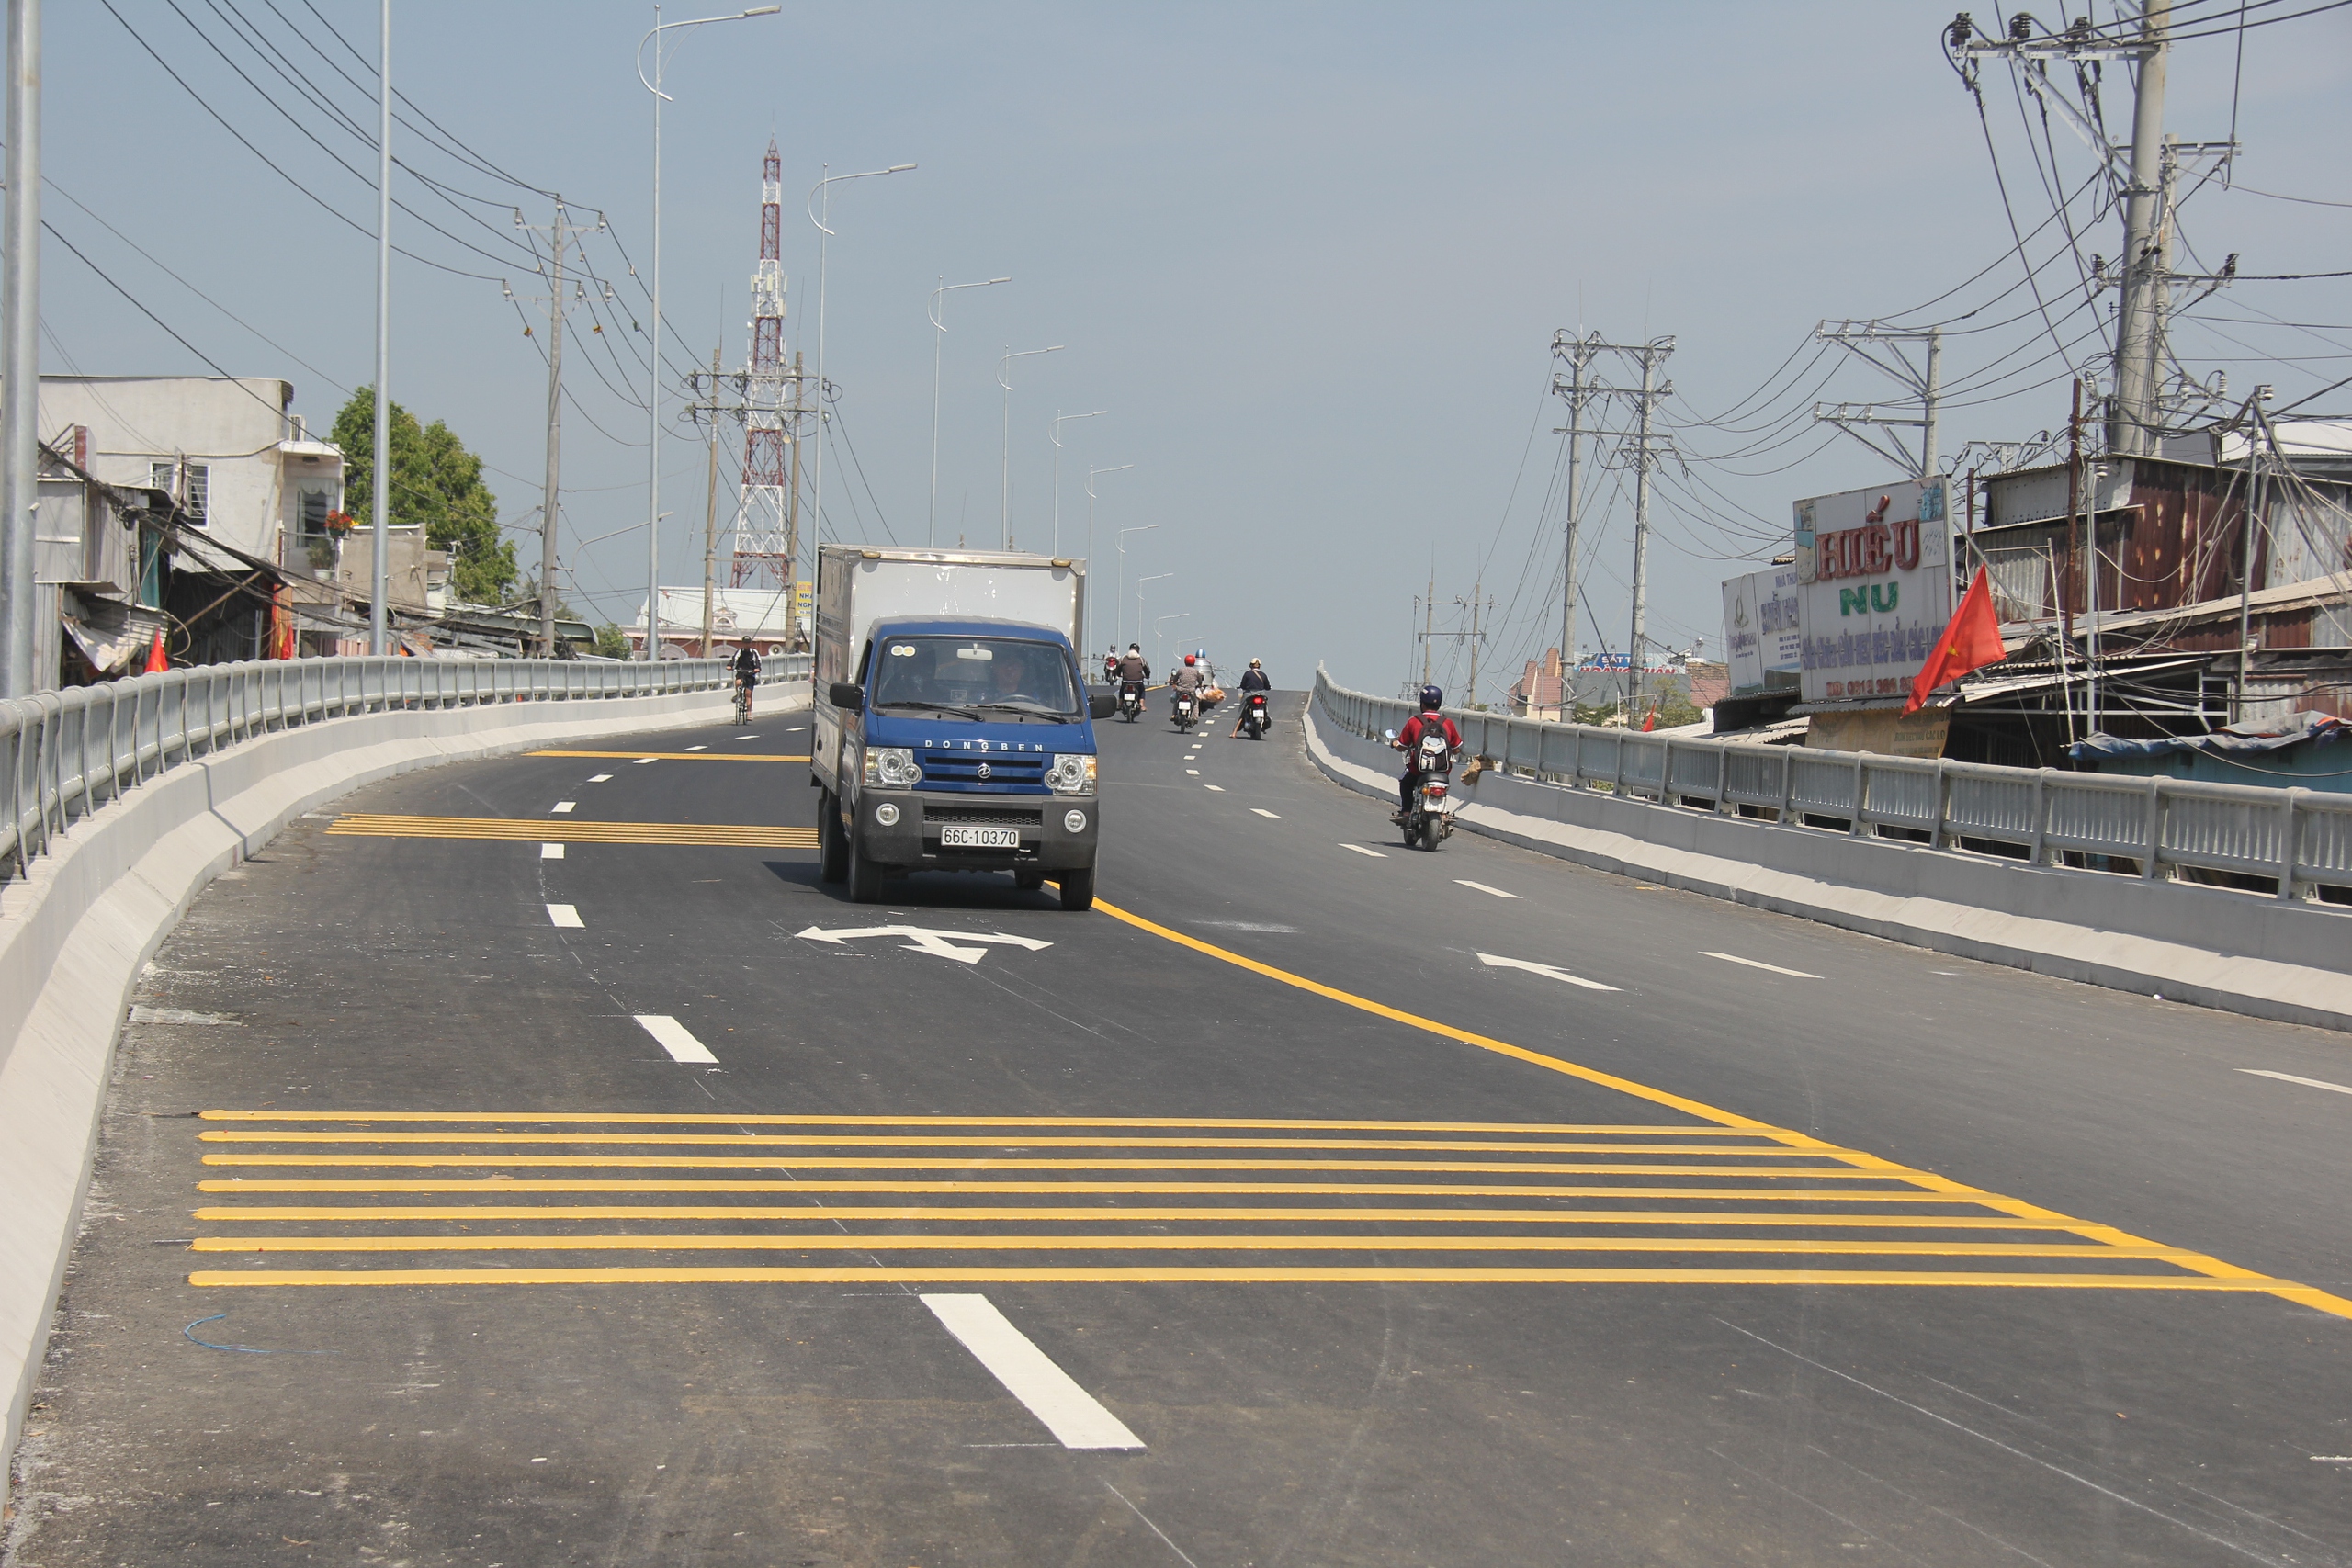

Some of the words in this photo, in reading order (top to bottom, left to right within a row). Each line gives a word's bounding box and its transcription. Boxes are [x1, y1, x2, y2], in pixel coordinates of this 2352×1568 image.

[1815, 495, 1920, 581] HIẾU
[1839, 581, 1899, 616] NU
[925, 740, 1043, 752] DONGBEN
[944, 829, 1017, 846] 66C-103.70
